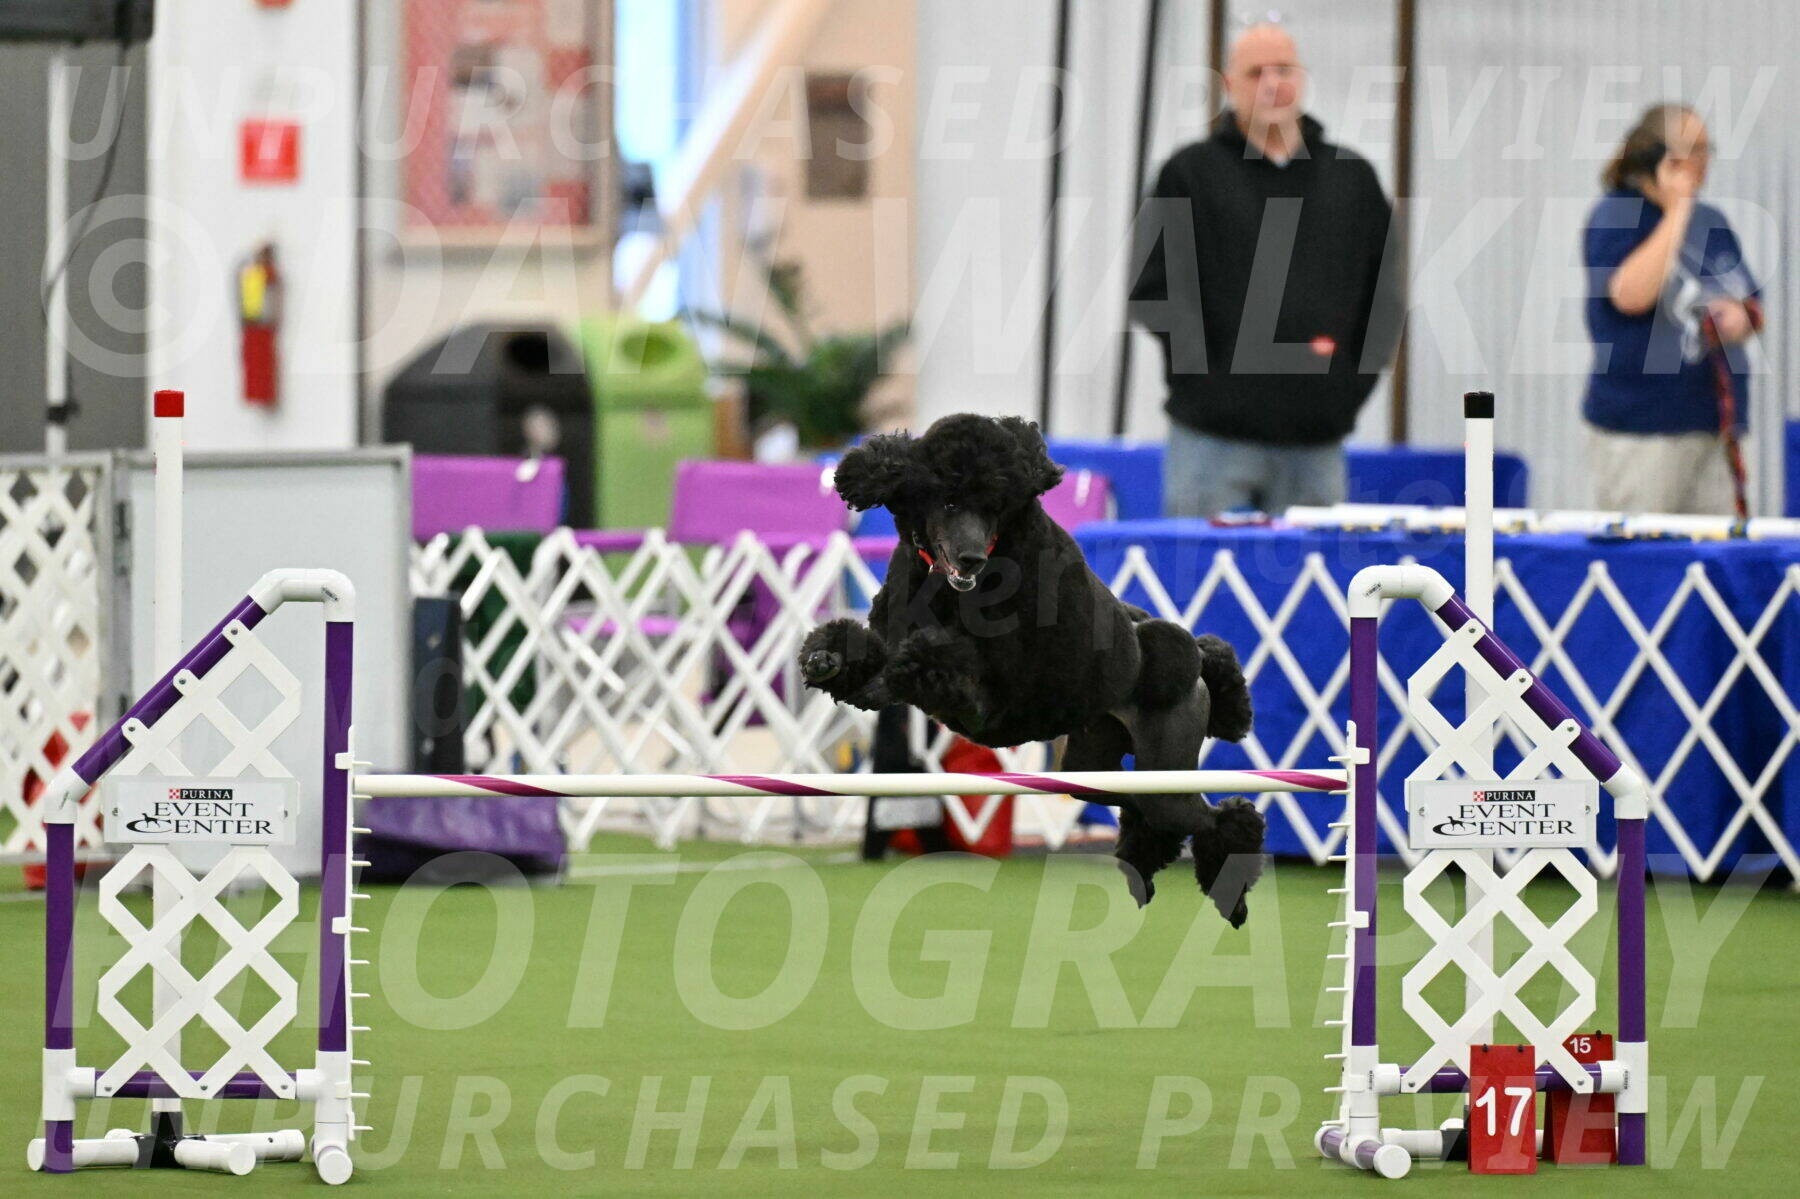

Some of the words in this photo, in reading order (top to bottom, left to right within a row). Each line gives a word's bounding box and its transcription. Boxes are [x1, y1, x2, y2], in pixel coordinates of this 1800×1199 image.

[182, 790, 231, 799] PURINA
[1486, 791, 1533, 800] PURINA
[154, 802, 254, 817] EVENT
[1459, 804, 1556, 819] EVENT
[126, 818, 275, 835] CENTER
[1432, 820, 1576, 837] CENTER
[1569, 1037, 1592, 1054] 15
[1475, 1086, 1532, 1137] 17
